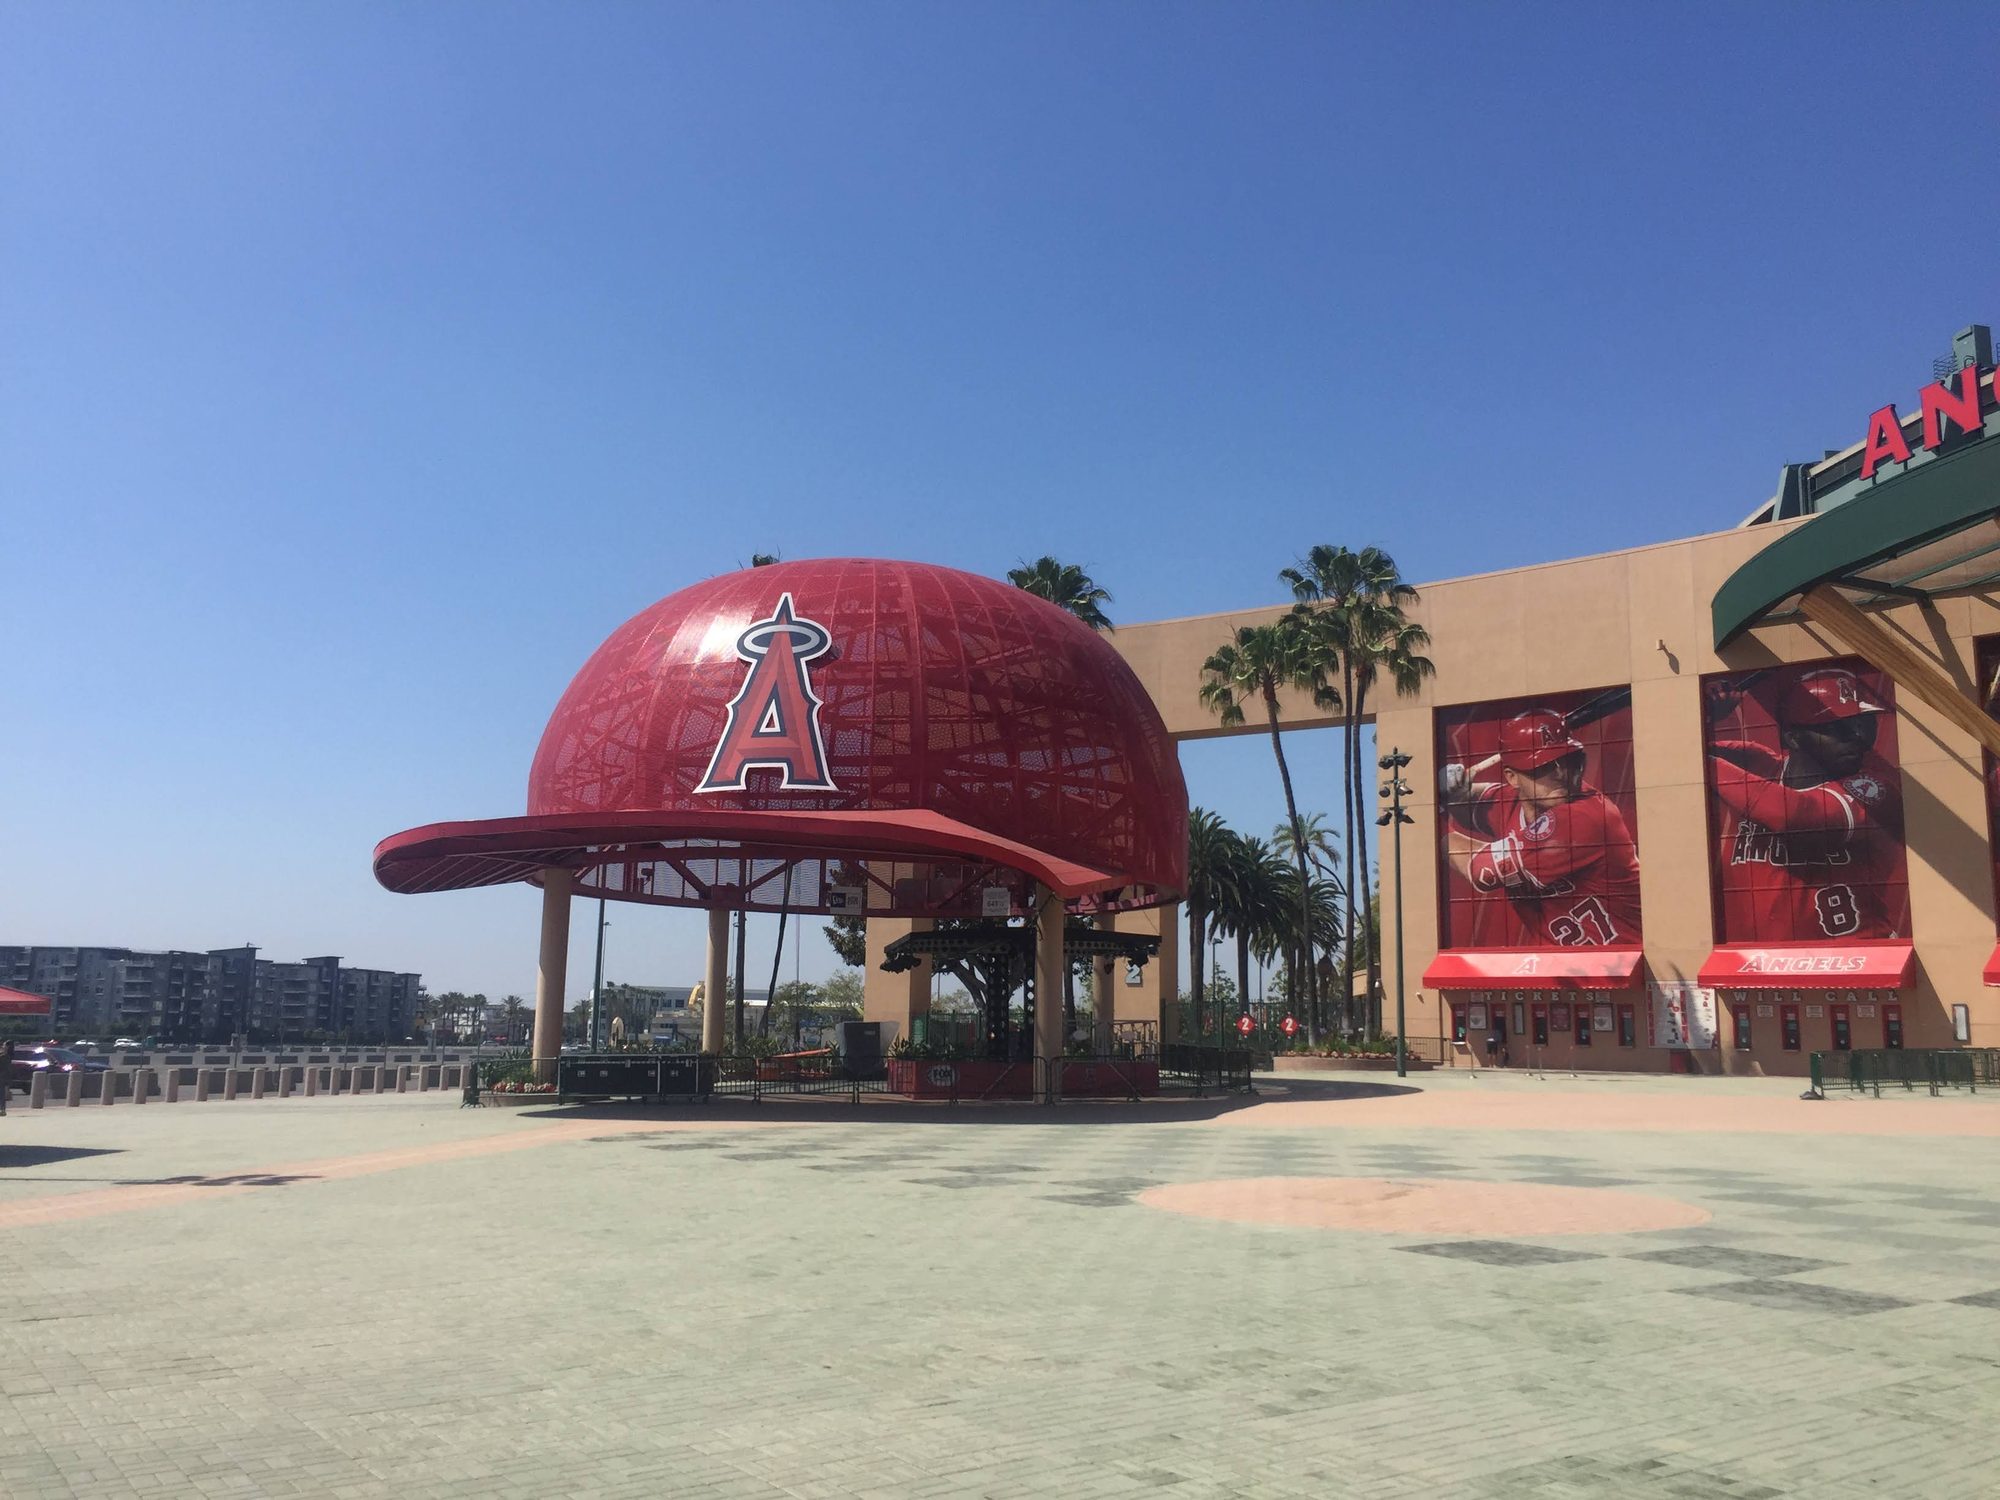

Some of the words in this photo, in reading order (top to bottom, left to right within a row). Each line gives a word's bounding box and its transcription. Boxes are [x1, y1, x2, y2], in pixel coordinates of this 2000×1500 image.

[1858, 363, 2000, 480] AN
[692, 591, 839, 793] A
[1730, 819, 1850, 866] ANGS
[1548, 894, 1619, 946] 27
[1814, 883, 1860, 937] 8
[1125, 964, 1141, 984] 2
[1511, 954, 1541, 975] A
[1484, 991, 1594, 1001] TICKETS
[1733, 991, 1802, 1002] WILL
[1824, 990, 1898, 1002] CALL
[1241, 1017, 1250, 1031] 2
[1285, 1017, 1293, 1032] 2
